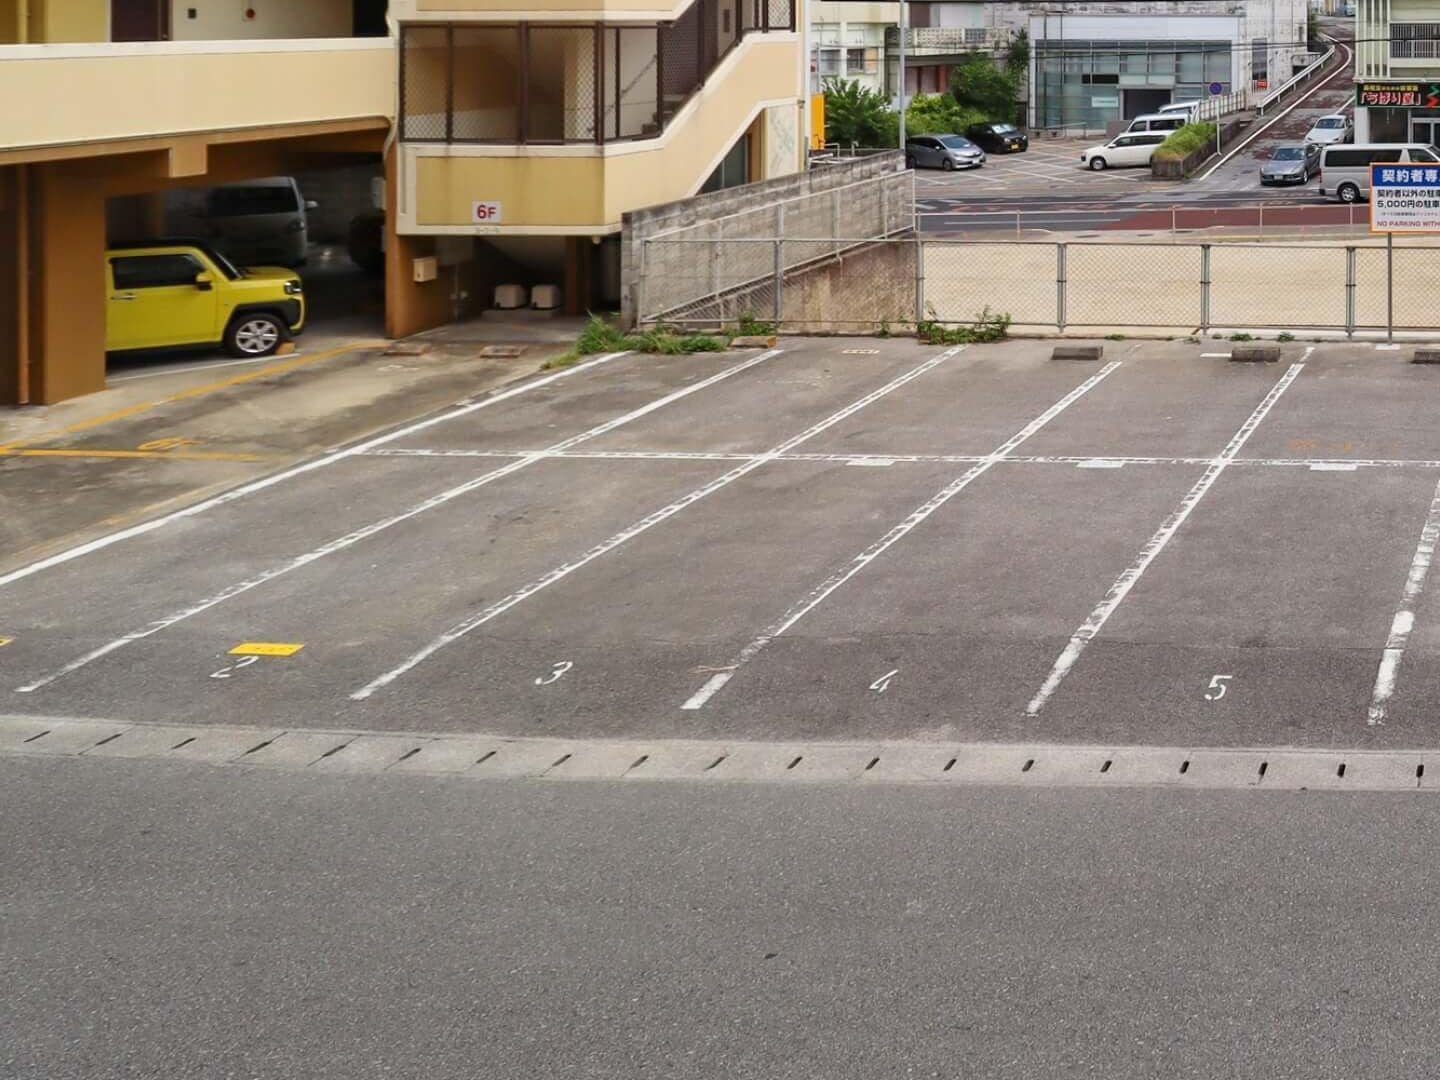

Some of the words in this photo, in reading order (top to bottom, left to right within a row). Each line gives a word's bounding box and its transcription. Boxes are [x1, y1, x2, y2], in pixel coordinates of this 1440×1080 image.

[477, 204, 496, 219] 6F
[535, 661, 573, 685] 3
[869, 669, 898, 693] 4
[1204, 674, 1233, 701] 5
